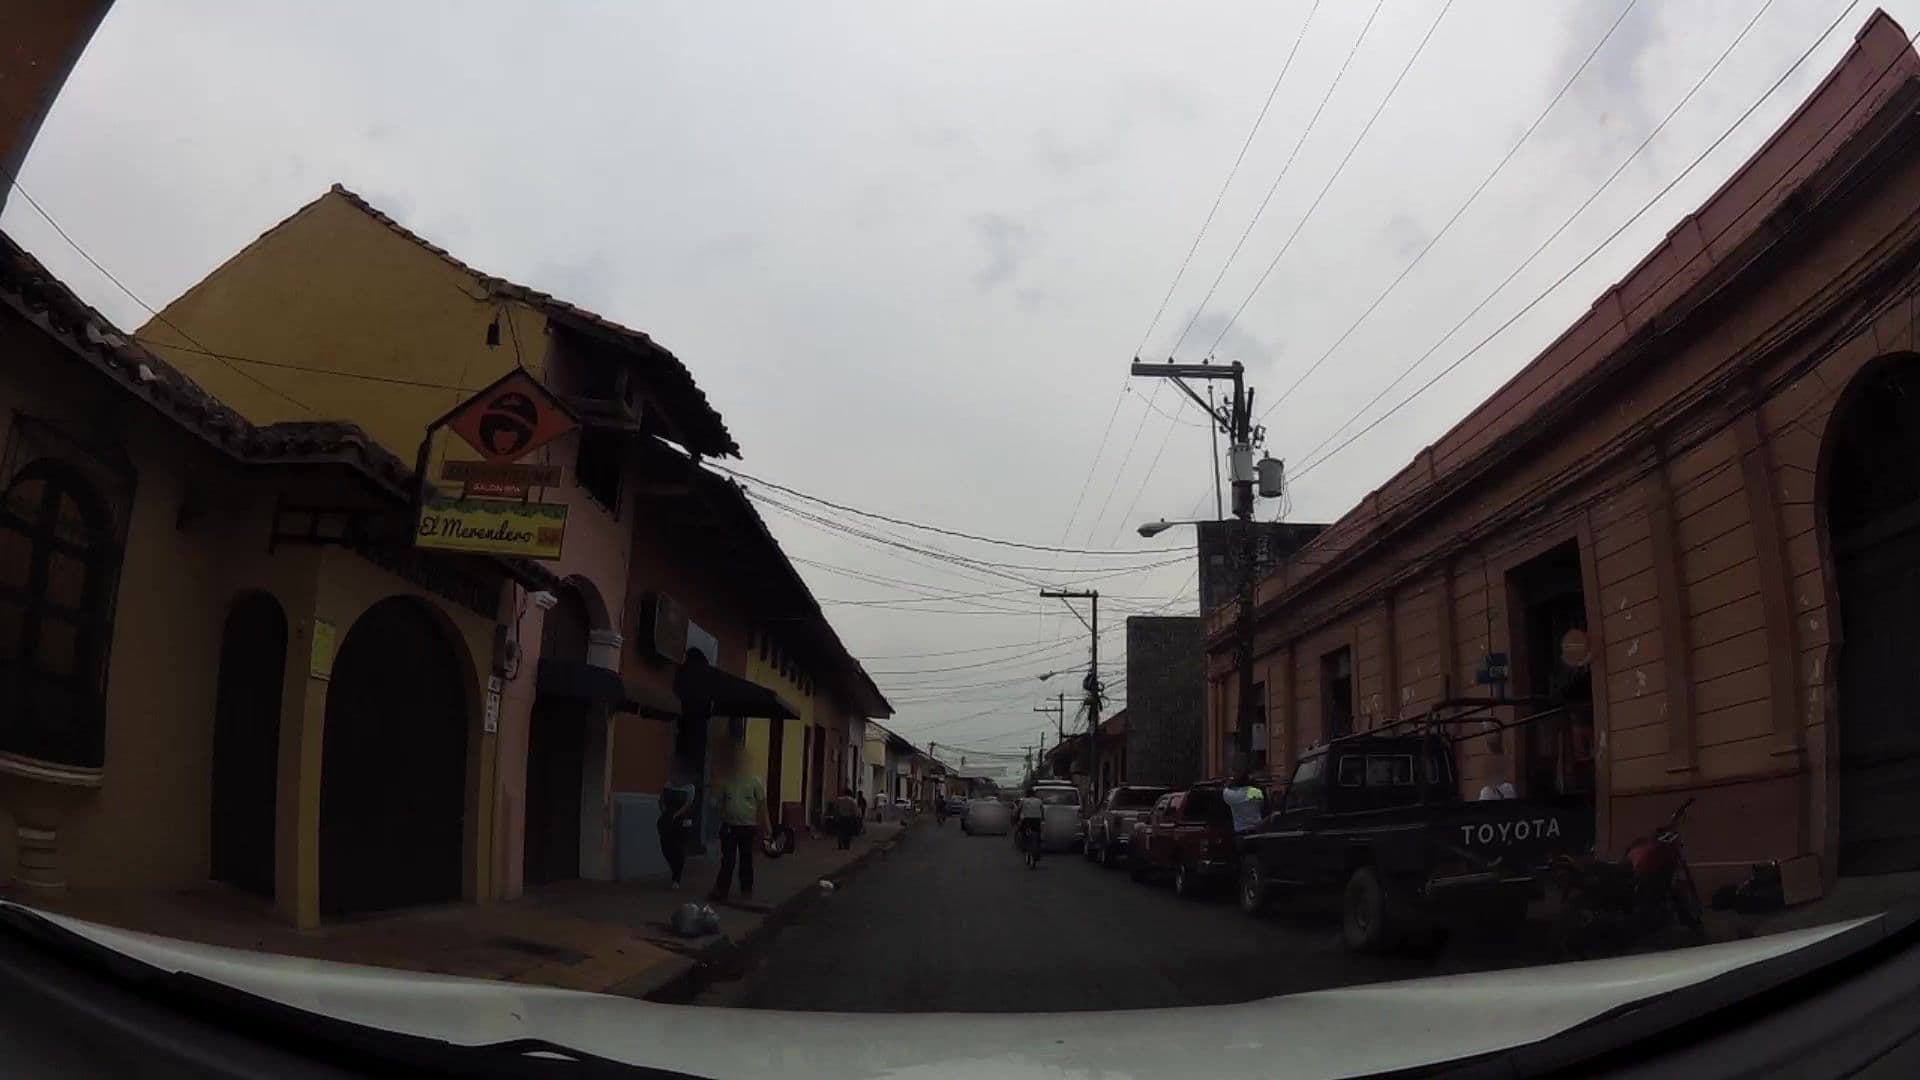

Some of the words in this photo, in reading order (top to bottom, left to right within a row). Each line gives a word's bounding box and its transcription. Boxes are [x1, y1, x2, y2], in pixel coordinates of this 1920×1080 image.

[419, 516, 438, 536] El
[442, 518, 535, 543] Merendero
[1460, 817, 1561, 846] TOYOTA
